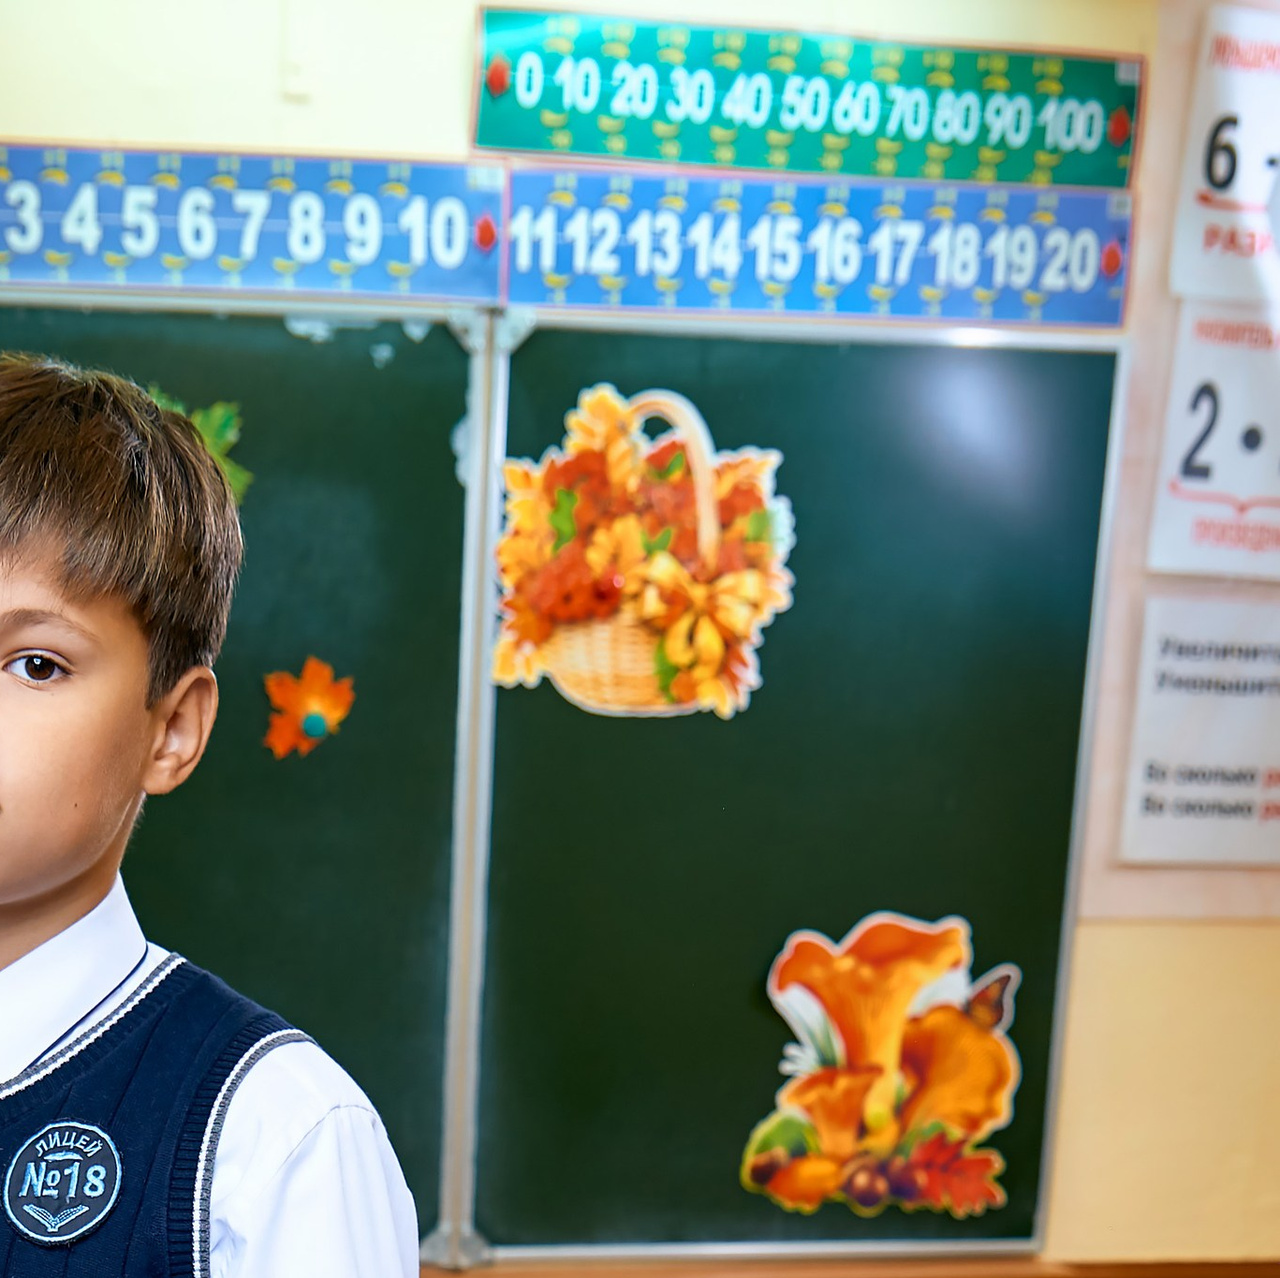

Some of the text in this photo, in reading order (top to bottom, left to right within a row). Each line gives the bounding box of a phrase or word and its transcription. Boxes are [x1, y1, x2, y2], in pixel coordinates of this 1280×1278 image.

[516, 51, 1104, 154] 0 10 20 30 40 50 60 70 80 90 100
[1205, 113, 1238, 191] 6
[3, 180, 44, 254] 3
[62, 182, 102, 255] 4
[121, 184, 160, 258] 5
[177, 186, 217, 261] 6
[231, 189, 271, 262] 7
[287, 190, 326, 263] 8
[343, 192, 383, 266] 9
[399, 194, 468, 270] 10
[509, 204, 1100, 295] 11 12 13 14 15 16 17 18 19 20
[1181, 380, 1219, 480] 2
[18, 1161, 107, 1200] №18
[35, 1131, 103, 1158] ЛИЦЕЙ
